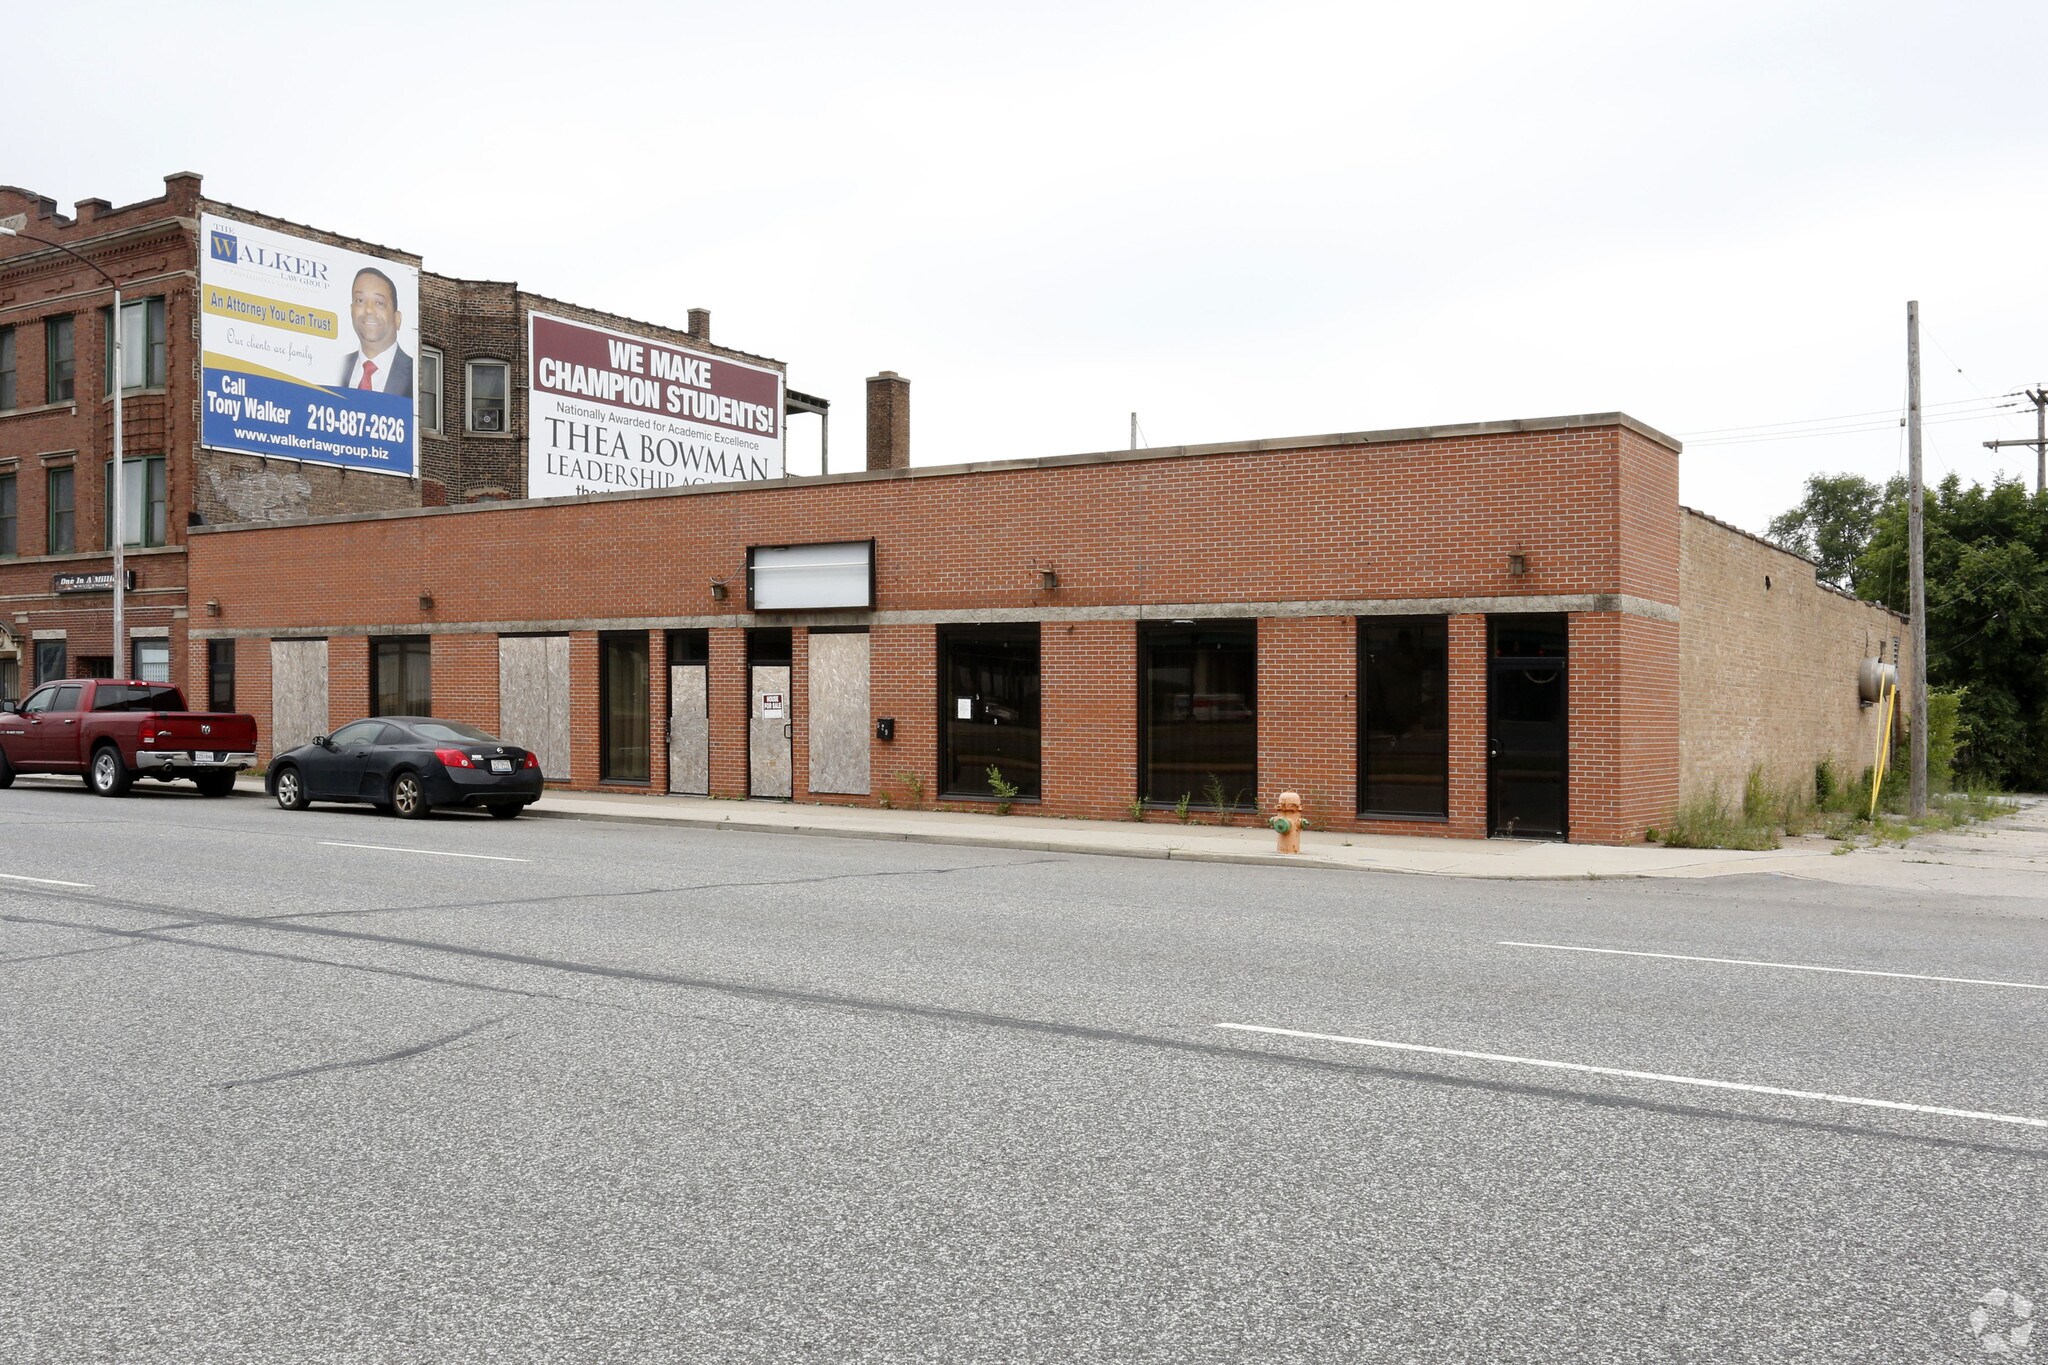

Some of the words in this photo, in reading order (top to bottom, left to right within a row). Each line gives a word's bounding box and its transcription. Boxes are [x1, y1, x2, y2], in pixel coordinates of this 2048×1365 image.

[213, 223, 235, 235] THE
[211, 236, 328, 281] WALKER
[281, 272, 298, 282] LAW
[299, 277, 330, 289] GROUP
[211, 292, 224, 308] An
[226, 295, 267, 321] Attorney
[269, 304, 286, 322] You
[288, 309, 306, 326] Can
[308, 313, 331, 331] Trust
[227, 327, 244, 347] Our
[246, 334, 271, 352] clients
[273, 346, 286, 355] are
[287, 341, 313, 365] family
[608, 339, 644, 374] WE
[650, 349, 712, 389] MAKE
[221, 375, 246, 396] Call
[539, 357, 660, 410] CHAMPION
[666, 384, 774, 434] STUDENTS!
[207, 390, 241, 422] Tony
[244, 397, 291, 425] Walker
[307, 403, 405, 444] 219-887-2626
[556, 401, 606, 423] Nationally
[608, 411, 650, 429] Awarded
[652, 420, 666, 433] for
[668, 423, 712, 442] Academic
[714, 432, 759, 451] Excellence
[234, 428, 389, 460] www.walkerlawgroup.biz
[544, 416, 631, 461] THEA
[639, 434, 769, 481] BOWMAN
[546, 453, 675, 489] LEADERSHIP
[60, 576, 75, 585] One
[86, 576, 92, 584] A
[94, 575, 115, 583] Milli
